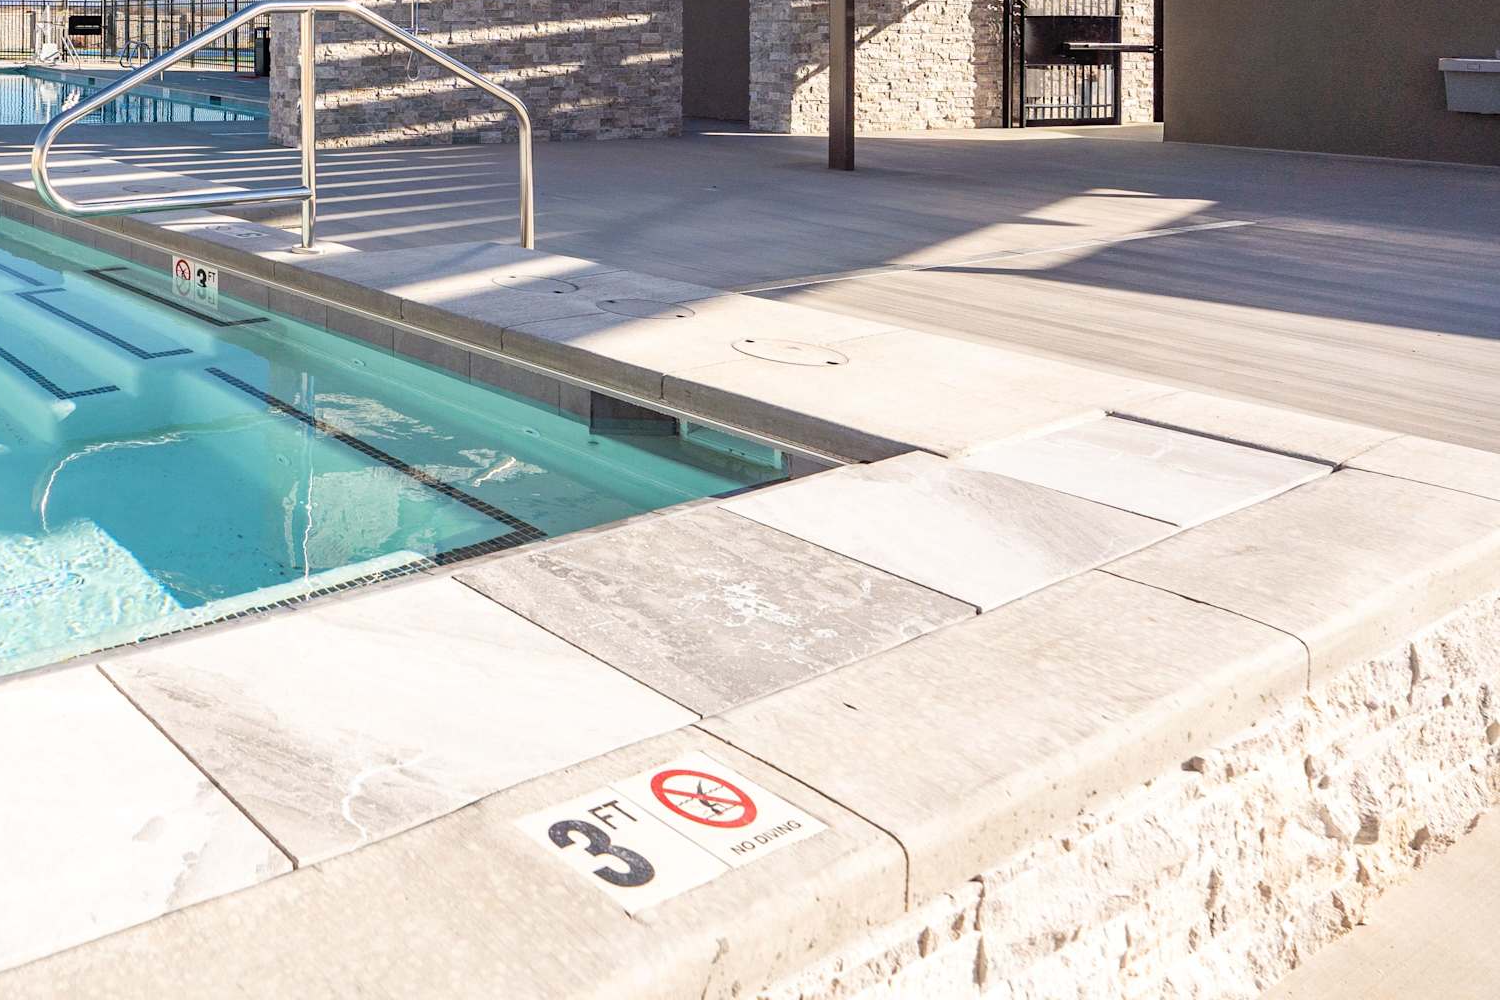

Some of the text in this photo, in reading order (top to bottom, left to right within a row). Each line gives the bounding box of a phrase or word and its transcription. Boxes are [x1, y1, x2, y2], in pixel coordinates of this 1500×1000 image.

[208, 271, 216, 283] FT
[548, 799, 656, 888] 3 FT
[730, 819, 802, 856] NO DIVING
